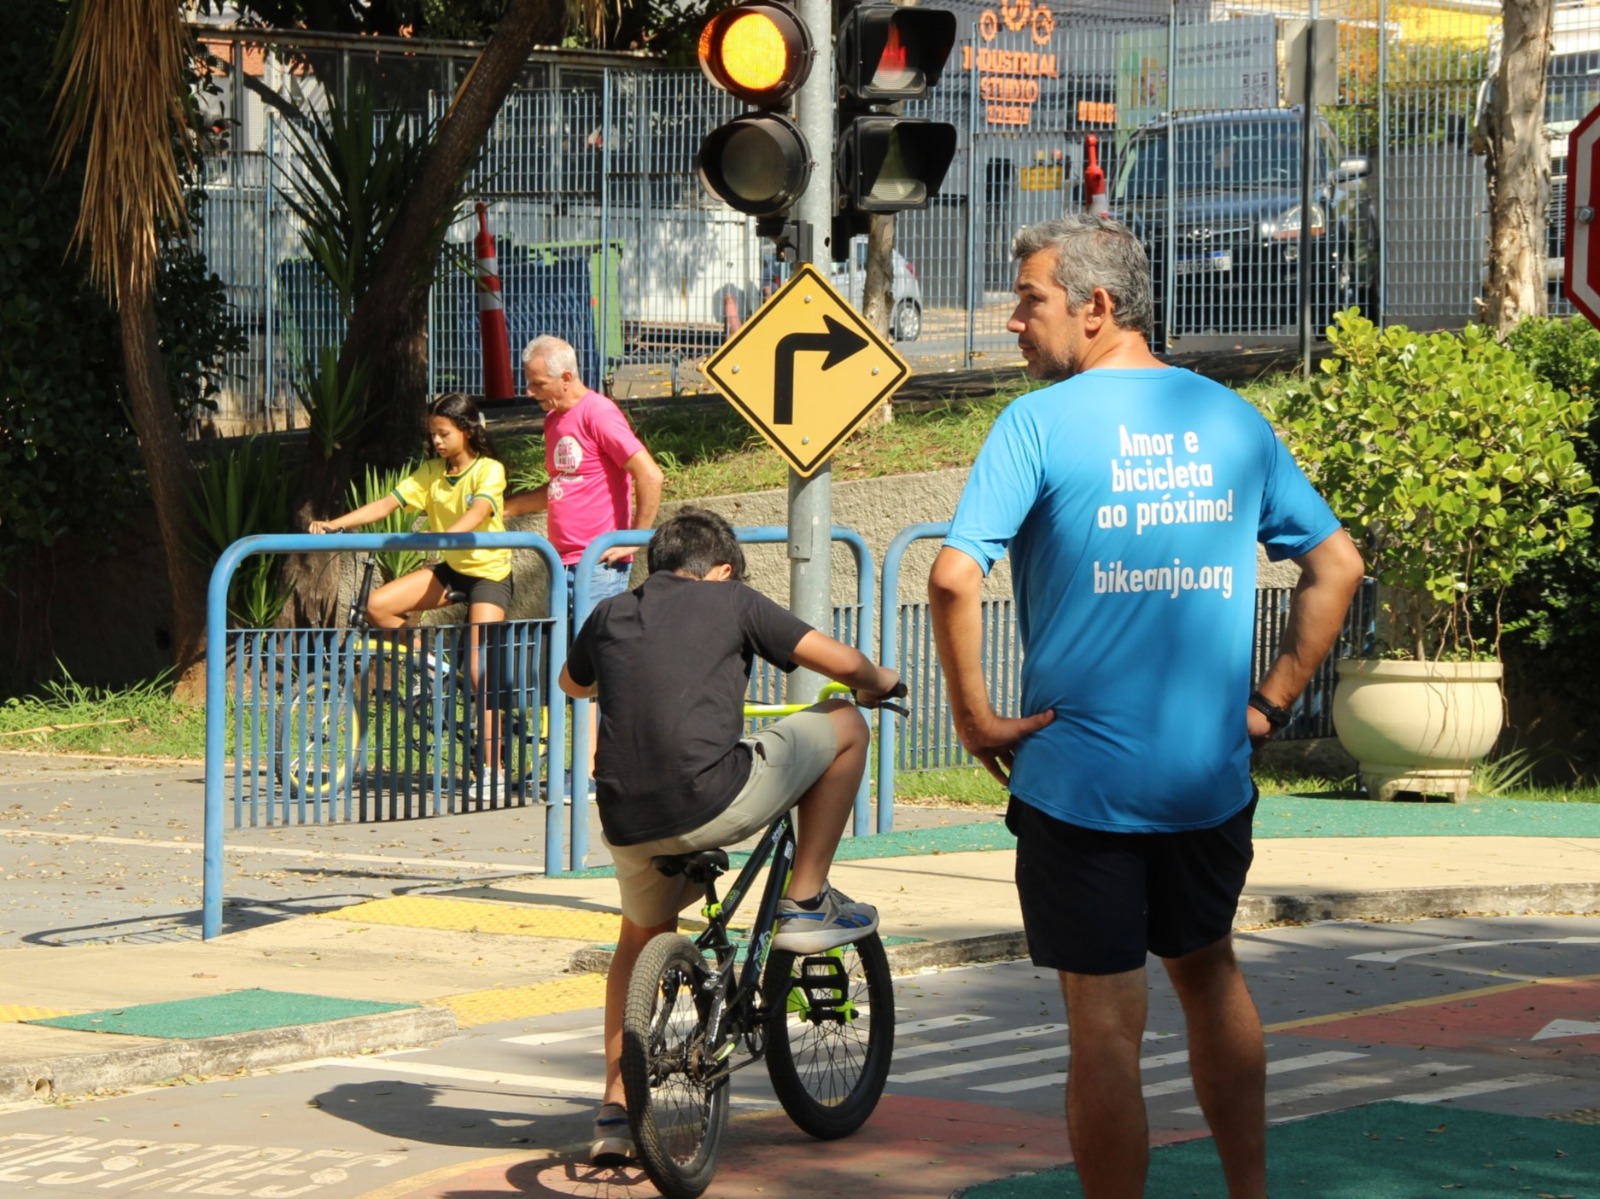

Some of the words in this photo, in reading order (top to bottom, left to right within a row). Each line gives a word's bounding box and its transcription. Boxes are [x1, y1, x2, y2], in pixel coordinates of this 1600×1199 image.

[981, 76, 1039, 102] STUDIO
[558, 443, 573, 456] BIKE
[1118, 424, 1174, 457] Amor
[1183, 431, 1199, 453] e
[1111, 457, 1213, 492] bicicleta
[1097, 504, 1128, 529] ao
[1136, 489, 1234, 535] próximo!
[1093, 558, 1234, 599] bikeanjo.org
